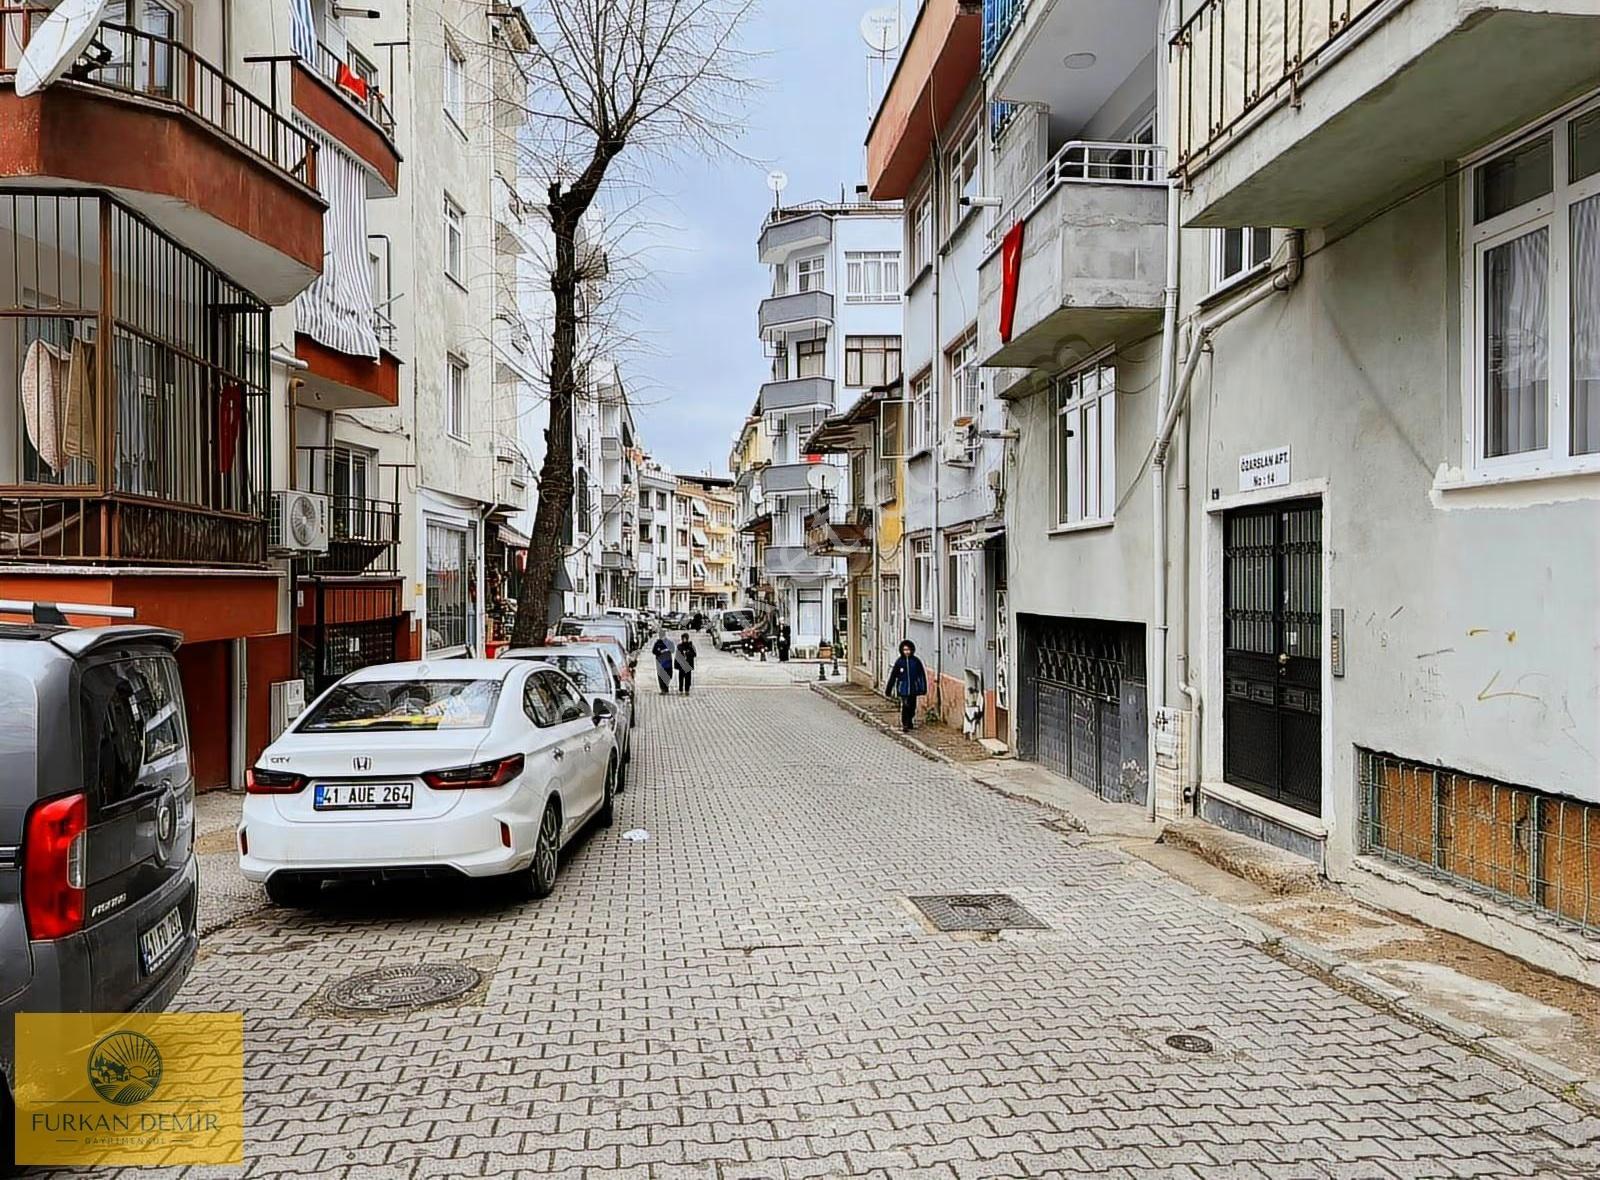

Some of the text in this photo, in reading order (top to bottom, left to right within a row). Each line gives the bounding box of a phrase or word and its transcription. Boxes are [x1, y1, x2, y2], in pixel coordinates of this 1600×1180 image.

[270, 756, 291, 764] CITY
[324, 787, 339, 803] 41
[348, 787, 375, 803] AUE
[383, 786, 409, 802] 264
